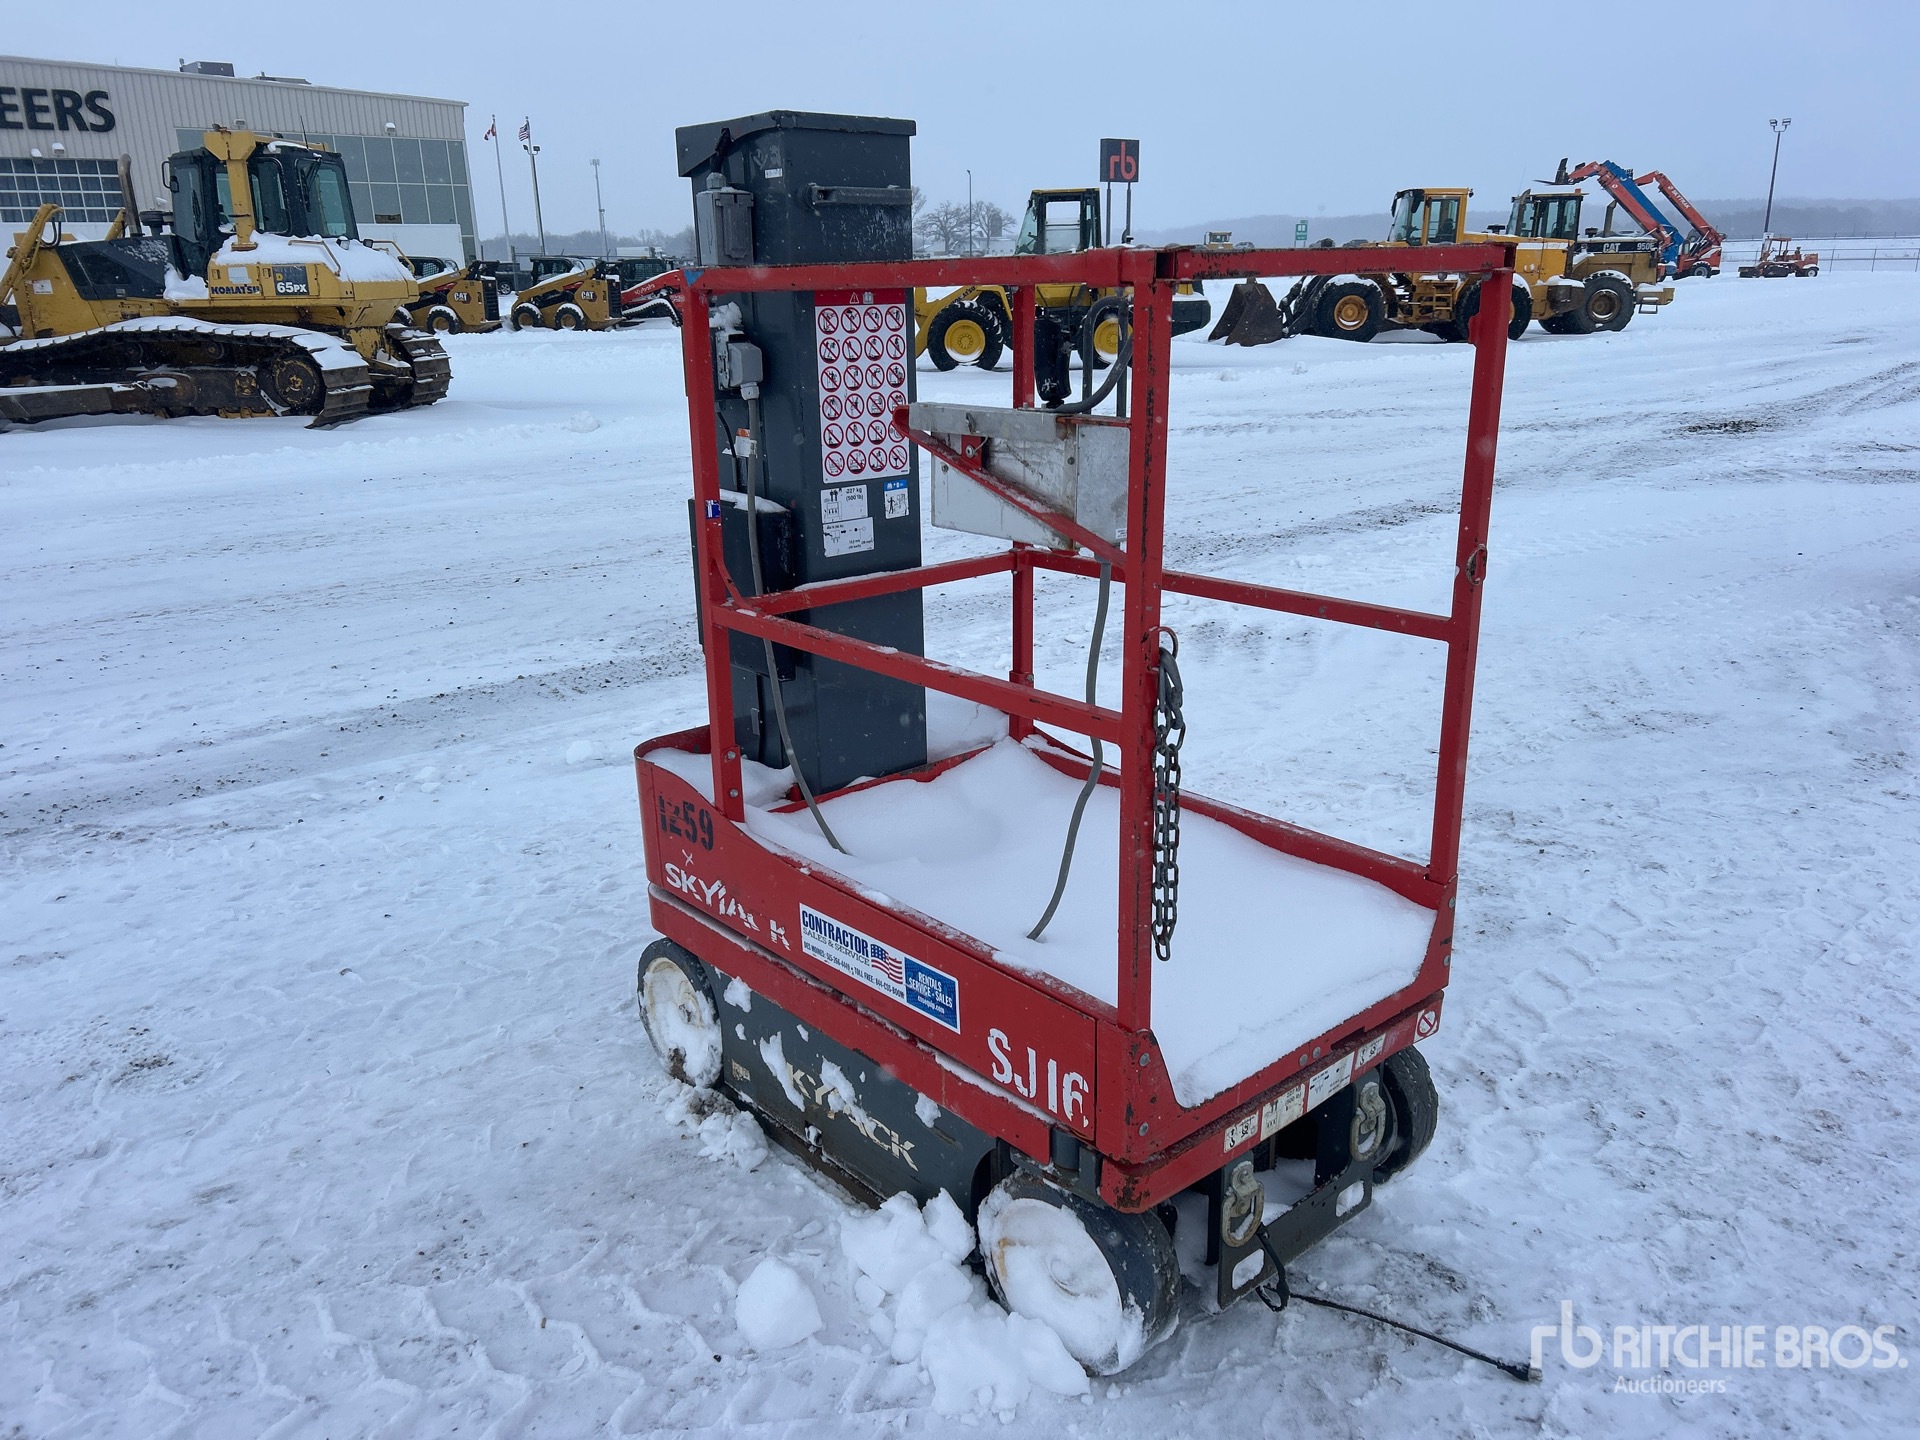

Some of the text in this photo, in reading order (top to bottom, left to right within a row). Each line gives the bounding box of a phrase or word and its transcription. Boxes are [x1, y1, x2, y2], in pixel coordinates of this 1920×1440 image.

[0, 86, 116, 132] EERS
[1109, 141, 1137, 180] rb
[1671, 190, 1691, 209] SKYTRAK
[1603, 243, 1621, 253] CAT
[206, 285, 260, 295] KOMATSU
[276, 282, 308, 293] 65PX
[454, 292, 468, 301] CAT
[581, 291, 594, 300] CAT
[801, 910, 869, 958] CONTRACTOR
[802, 927, 870, 967] SALES & SERVICE
[853, 966, 864, 979] TOLL
[918, 971, 942, 993] RENTALS
[908, 976, 953, 1009] SERVICE SALES
[987, 1028, 1089, 1128] SJ16
